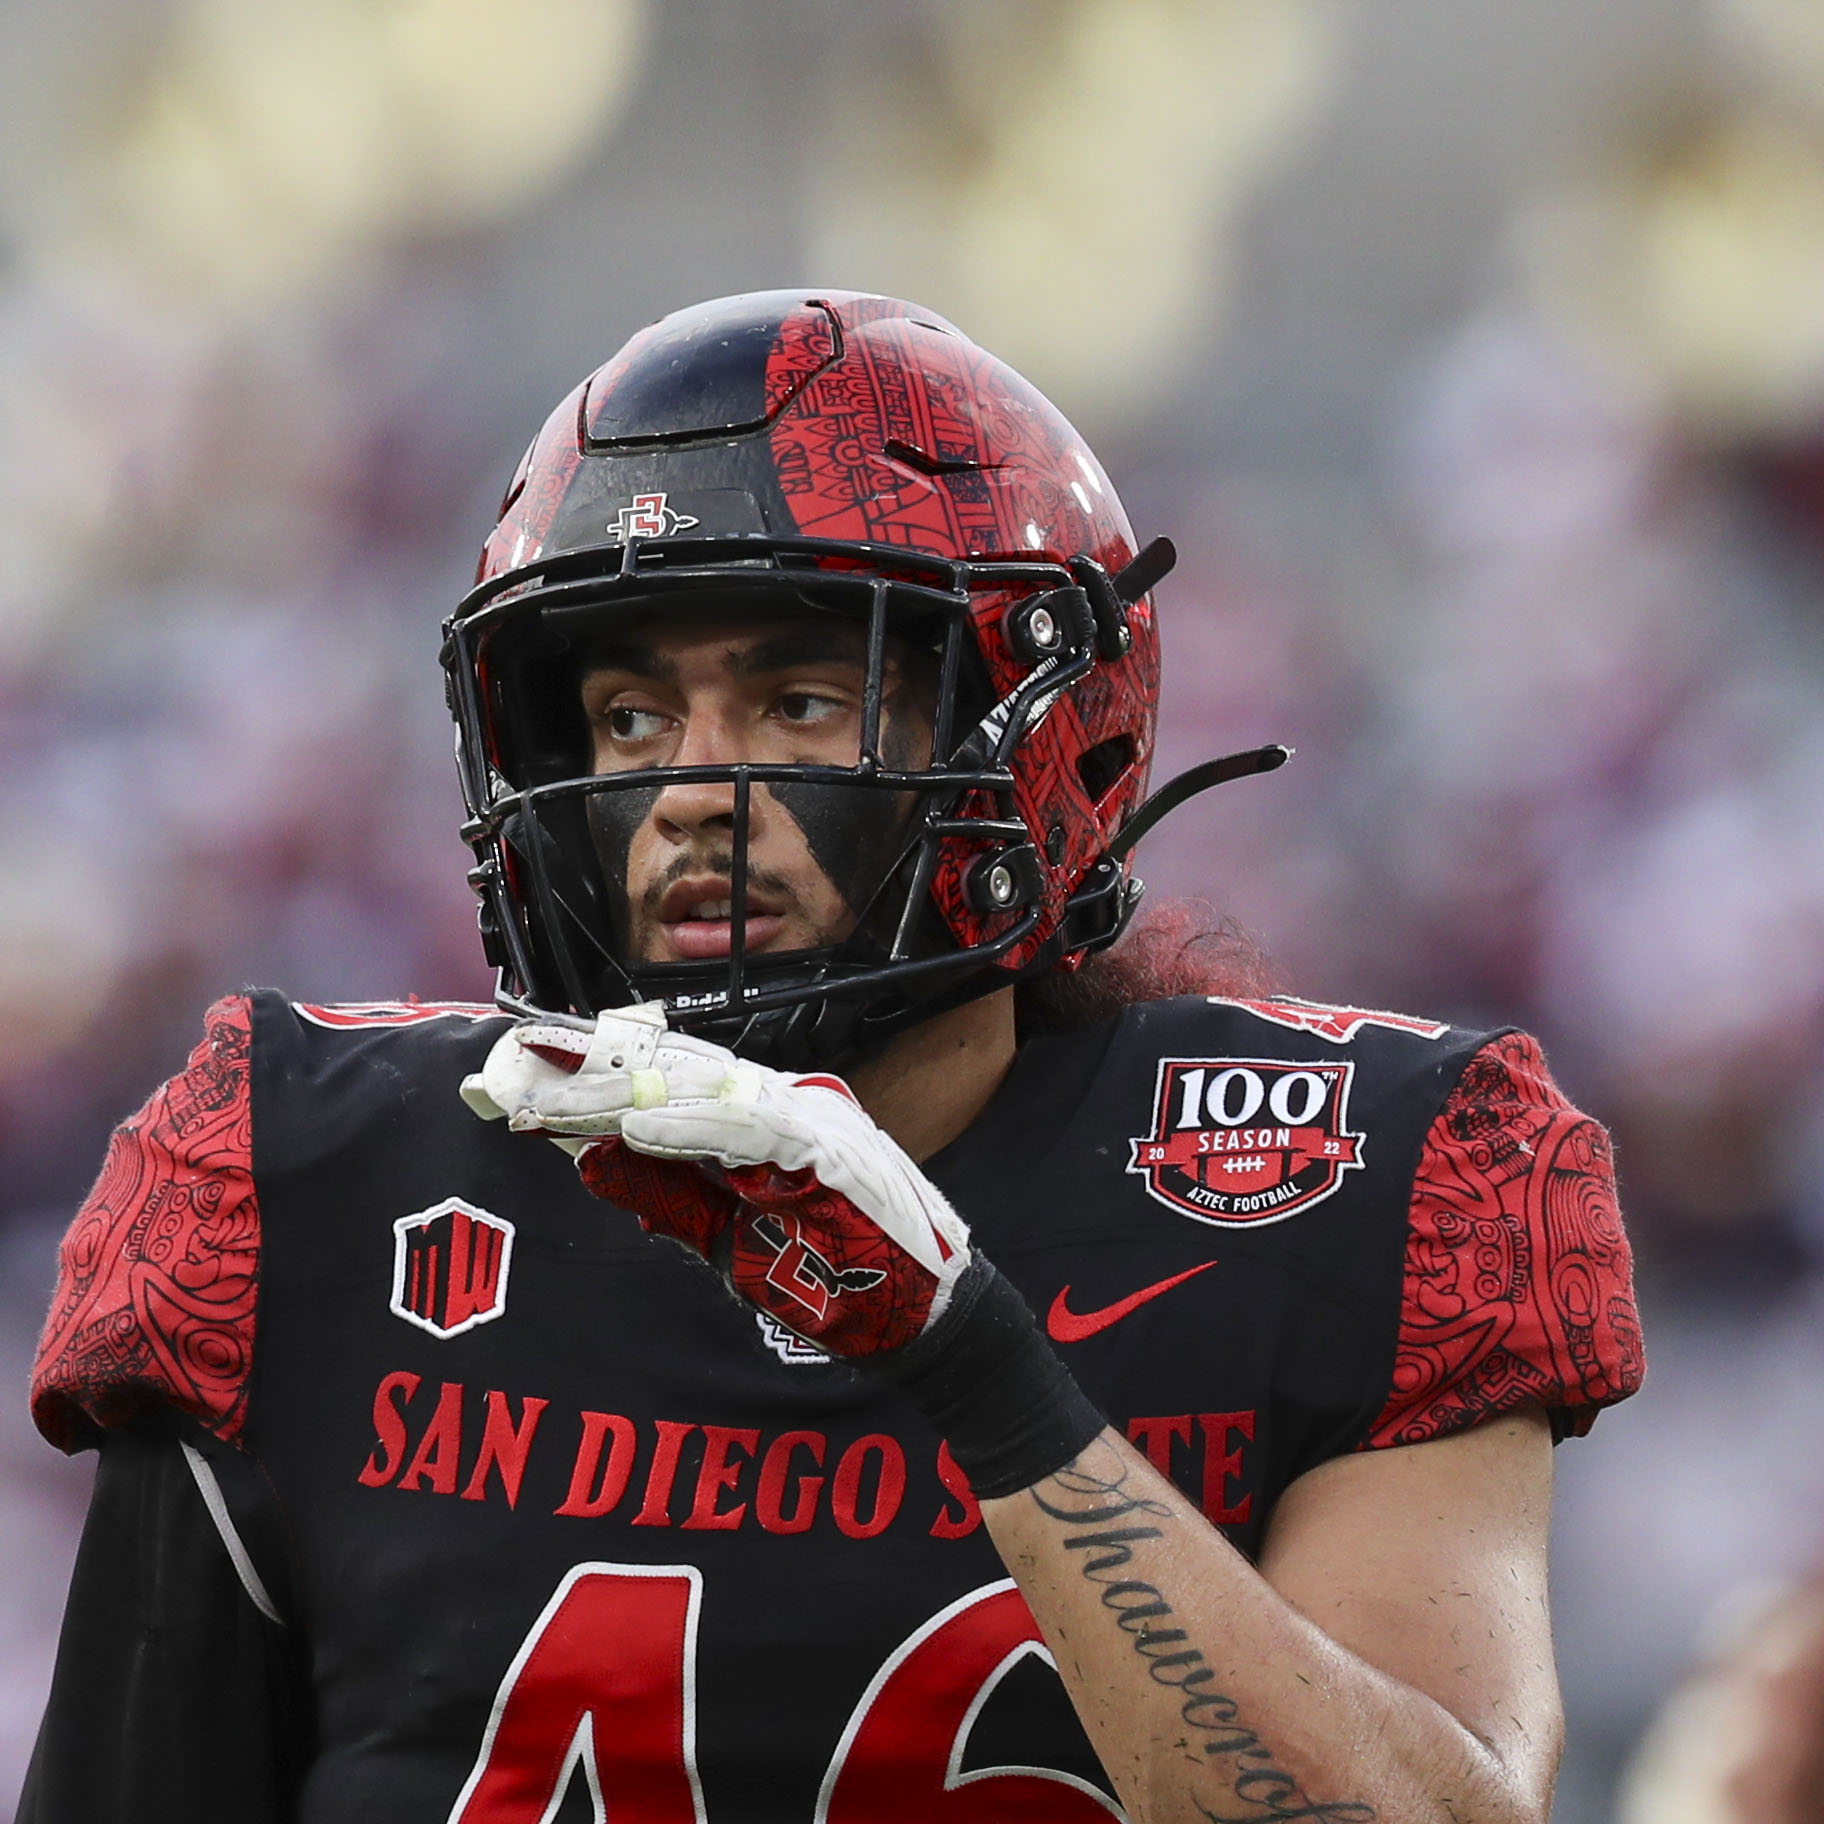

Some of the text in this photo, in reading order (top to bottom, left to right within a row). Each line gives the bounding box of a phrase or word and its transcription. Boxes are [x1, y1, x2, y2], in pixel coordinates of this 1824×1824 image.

[676, 988, 758, 1008] Riddll
[1148, 1142, 1340, 1160] 20 22
[1197, 1128, 1291, 1152] SEASON
[1186, 1181, 1302, 1212] AZTEC FOOTBALL
[357, 1371, 549, 1511] SAN
[553, 1411, 907, 1539] DIEGO
